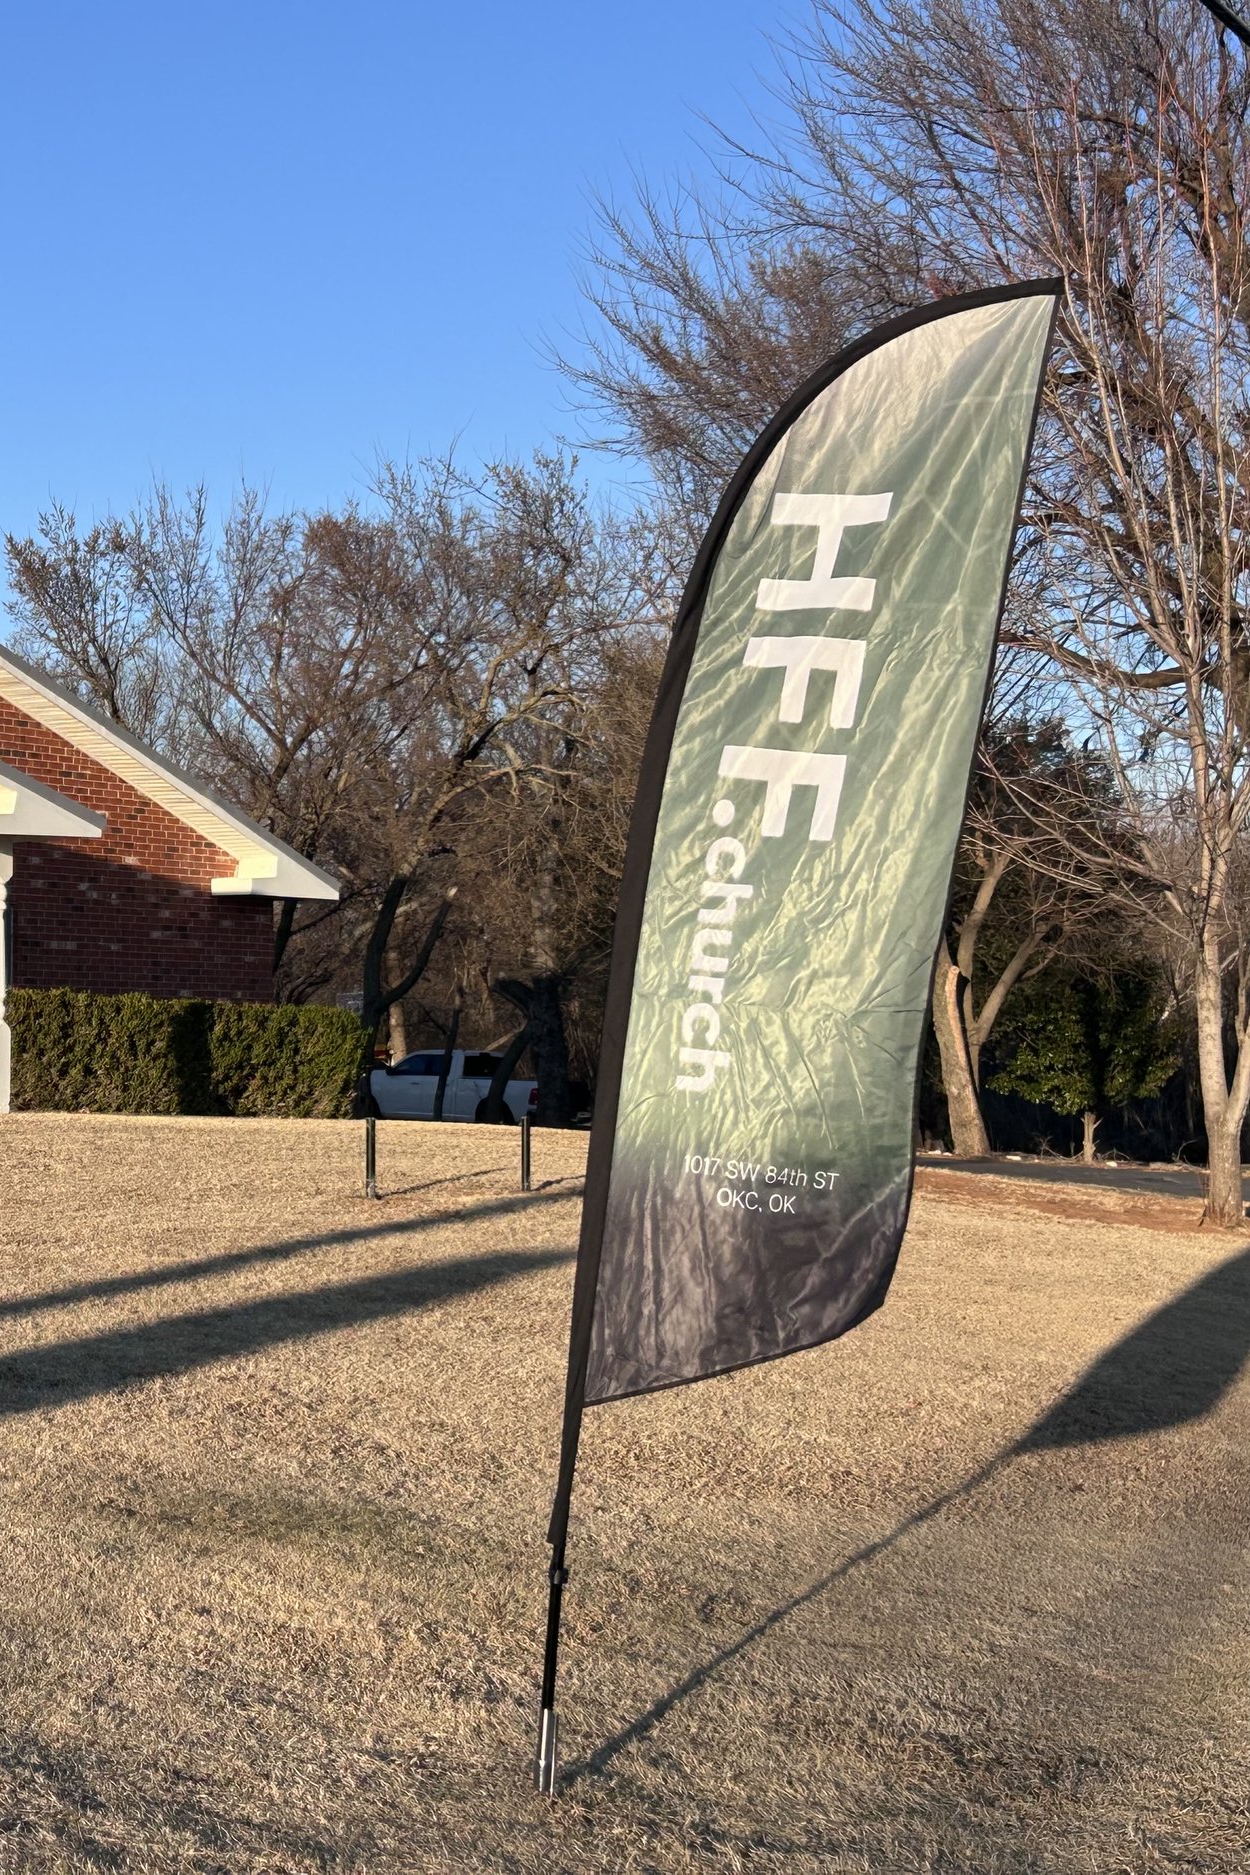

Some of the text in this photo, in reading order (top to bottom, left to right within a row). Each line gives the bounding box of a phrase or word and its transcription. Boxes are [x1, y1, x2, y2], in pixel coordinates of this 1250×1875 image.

[684, 1155, 840, 1191] 1017 SW 84th ST
[716, 1187, 797, 1214] OKC, OK
